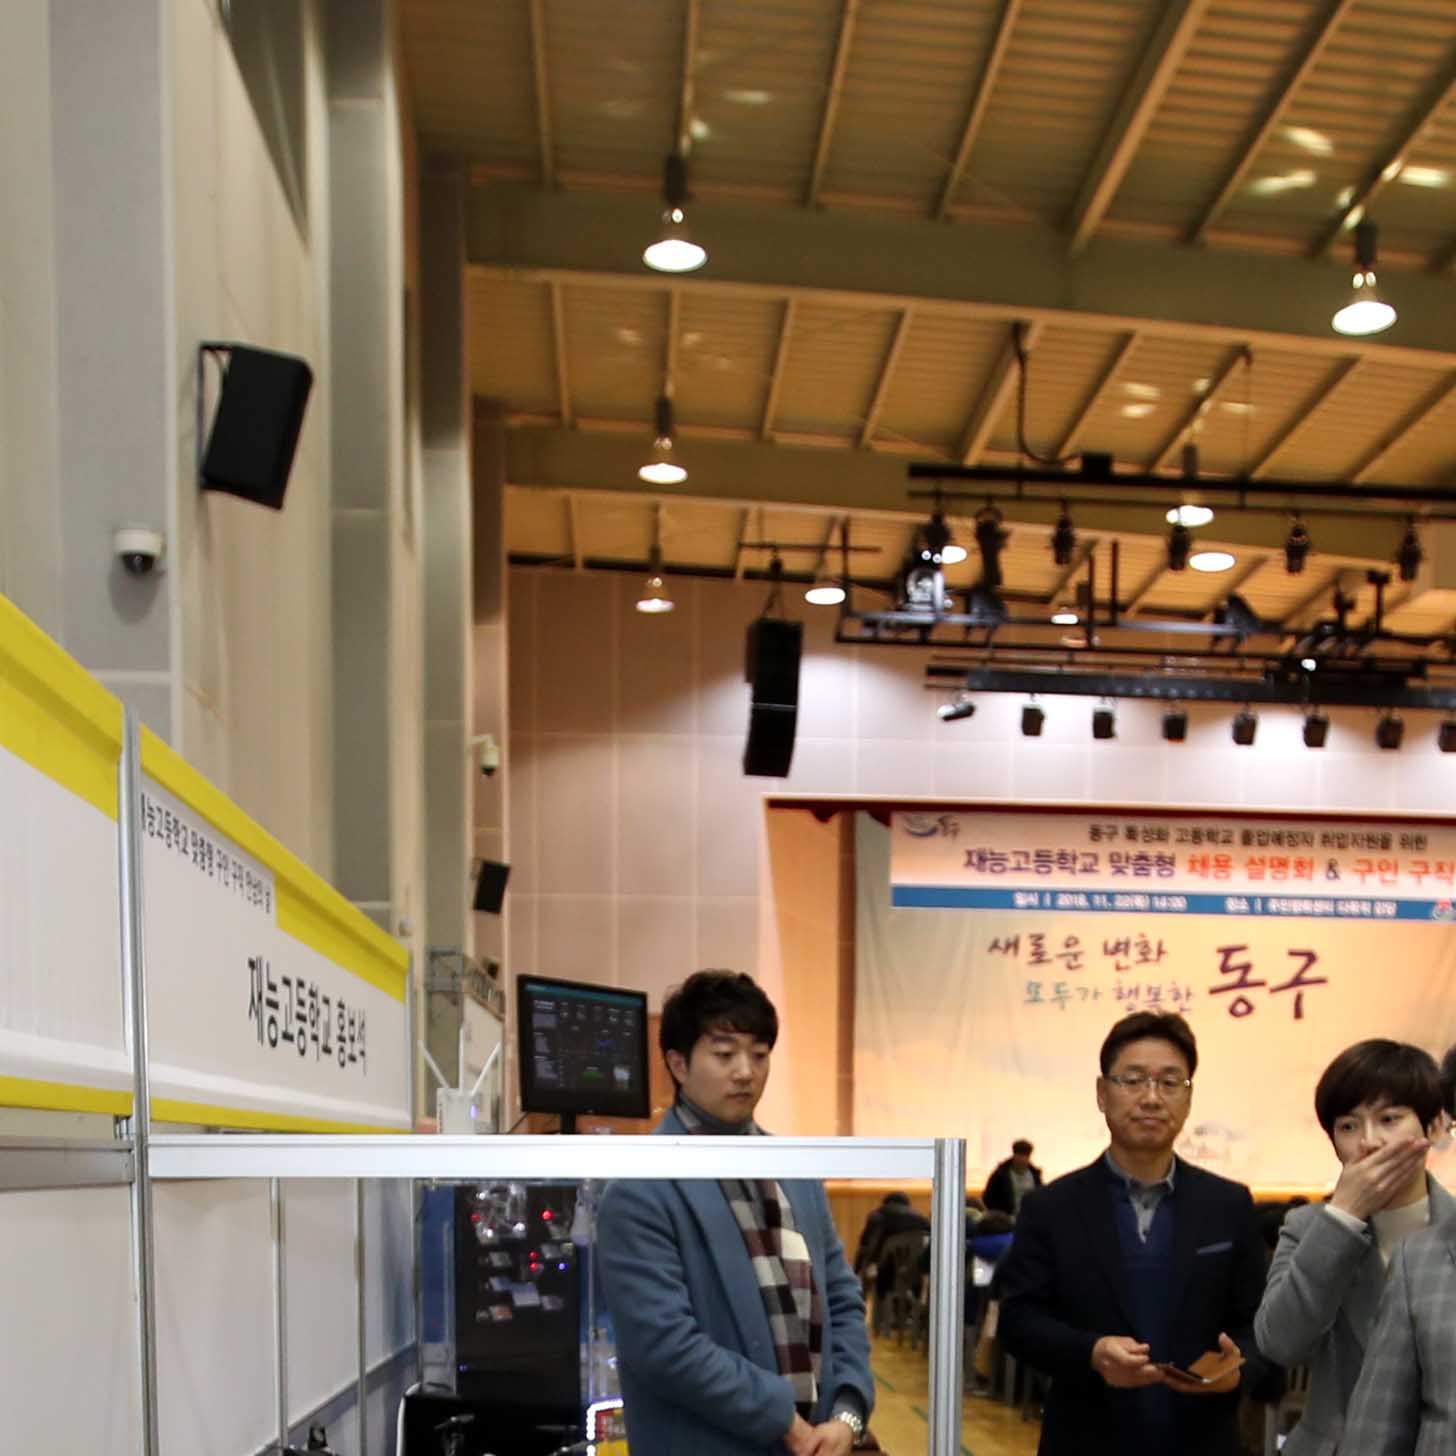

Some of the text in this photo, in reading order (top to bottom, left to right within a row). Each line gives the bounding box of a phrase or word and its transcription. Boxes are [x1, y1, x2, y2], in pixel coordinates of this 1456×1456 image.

[1175, 826, 1233, 845] 고등학교
[963, 848, 1099, 875] 재능고등학교
[1109, 851, 1176, 878] 맞춤형
[1187, 853, 1233, 880] 채용
[1246, 854, 1314, 882] 설명회
[1325, 858, 1340, 881] &
[1352, 857, 1399, 885] 구인
[1408, 858, 1455, 887] 구직
[987, 932, 1168, 971] 새로운 변화
[1024, 979, 1195, 1013] 모두가 행복한
[1208, 944, 1329, 1020] 동구
[247, 955, 368, 1077] 재능고등학교 홍보석
